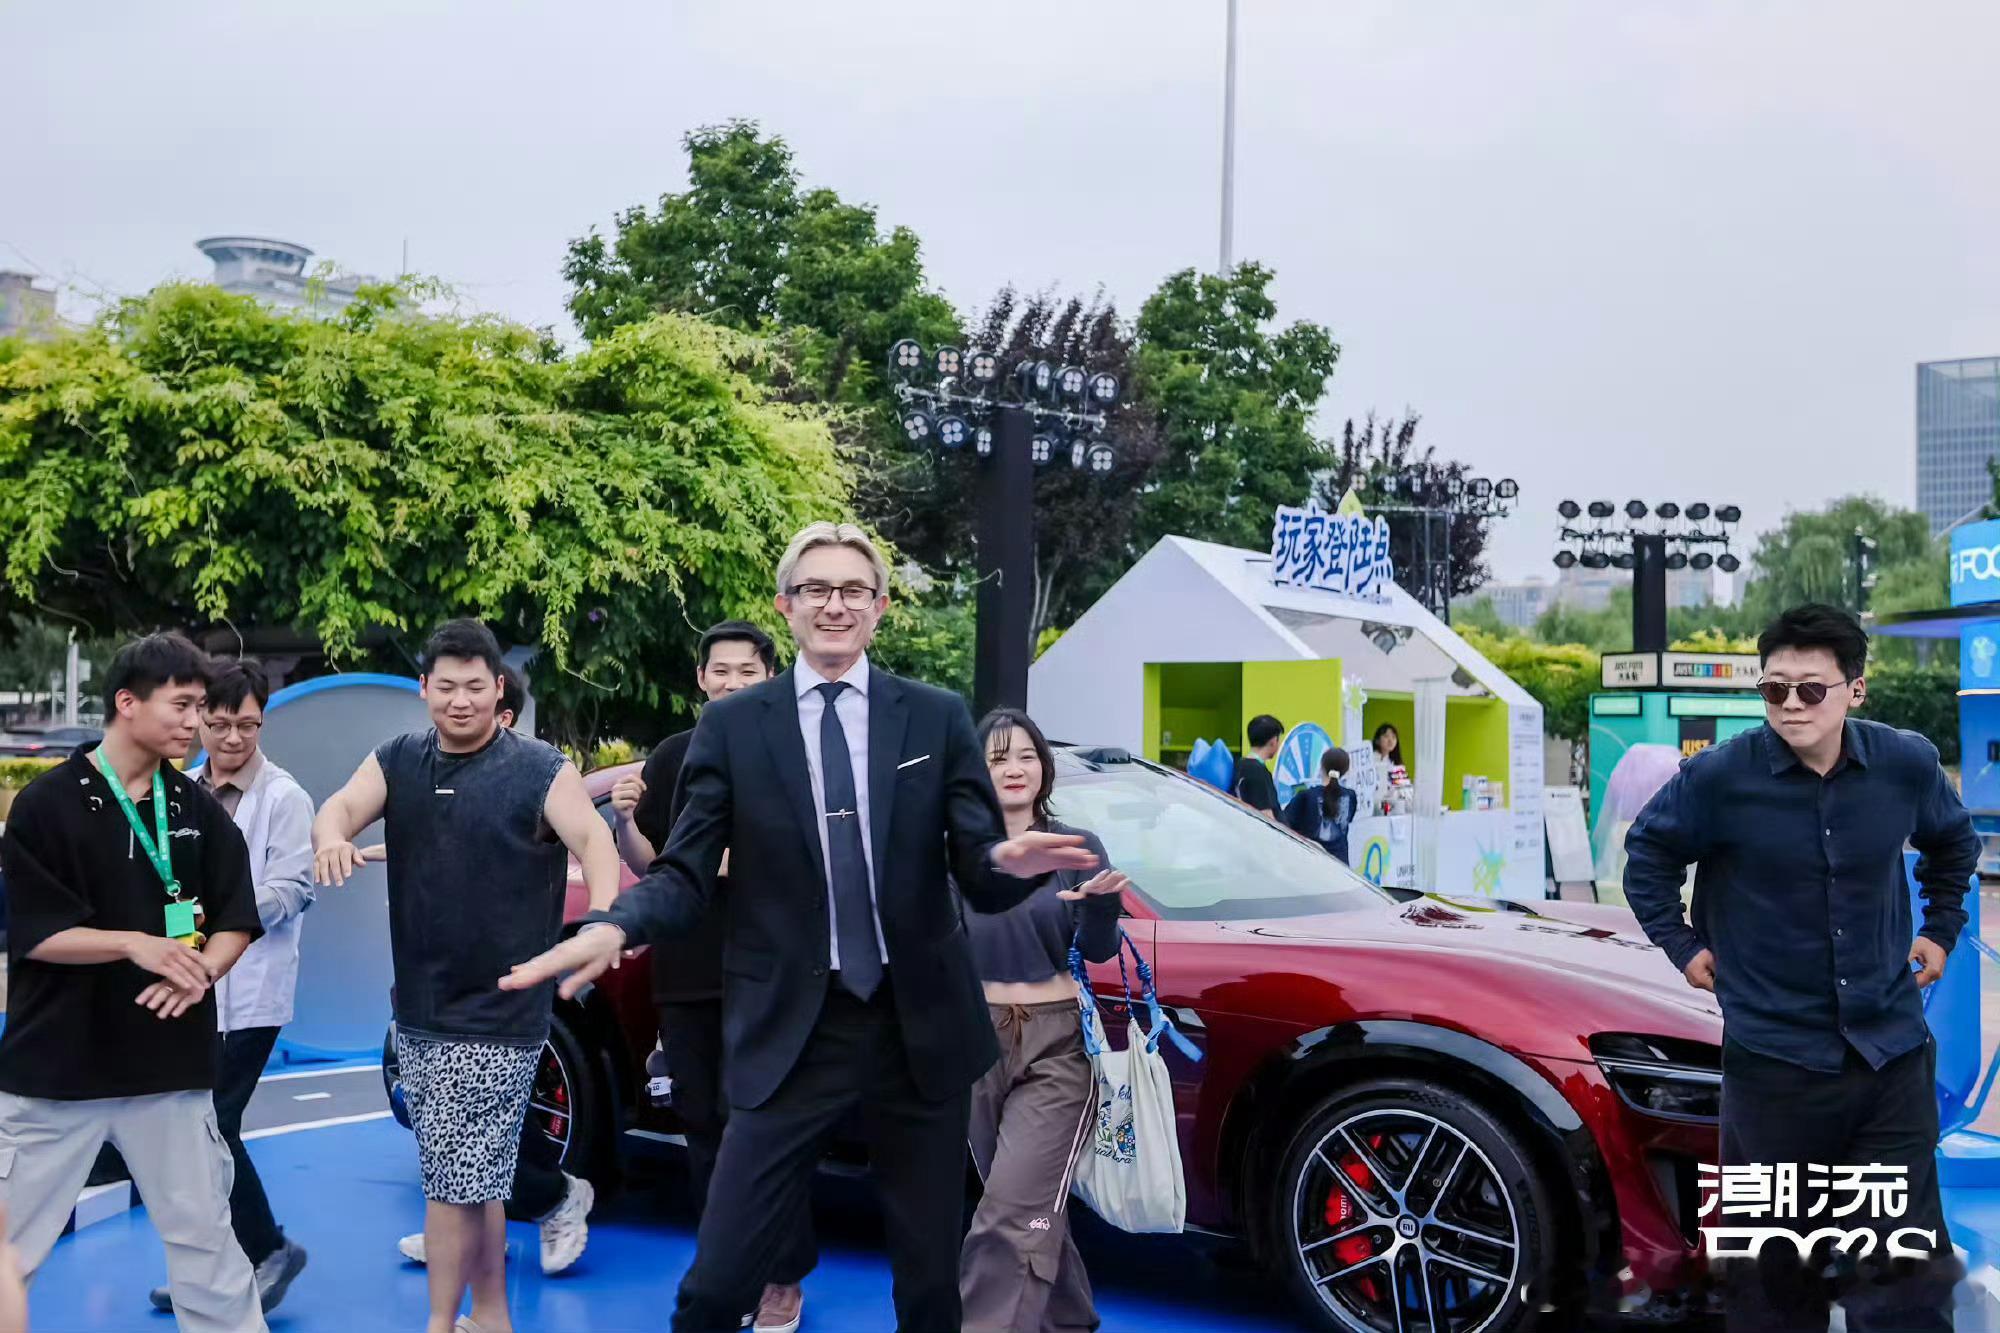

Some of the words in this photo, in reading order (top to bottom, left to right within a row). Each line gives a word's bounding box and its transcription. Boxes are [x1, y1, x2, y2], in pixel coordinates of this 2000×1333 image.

[1277, 508, 1392, 592] 玩家登陆点
